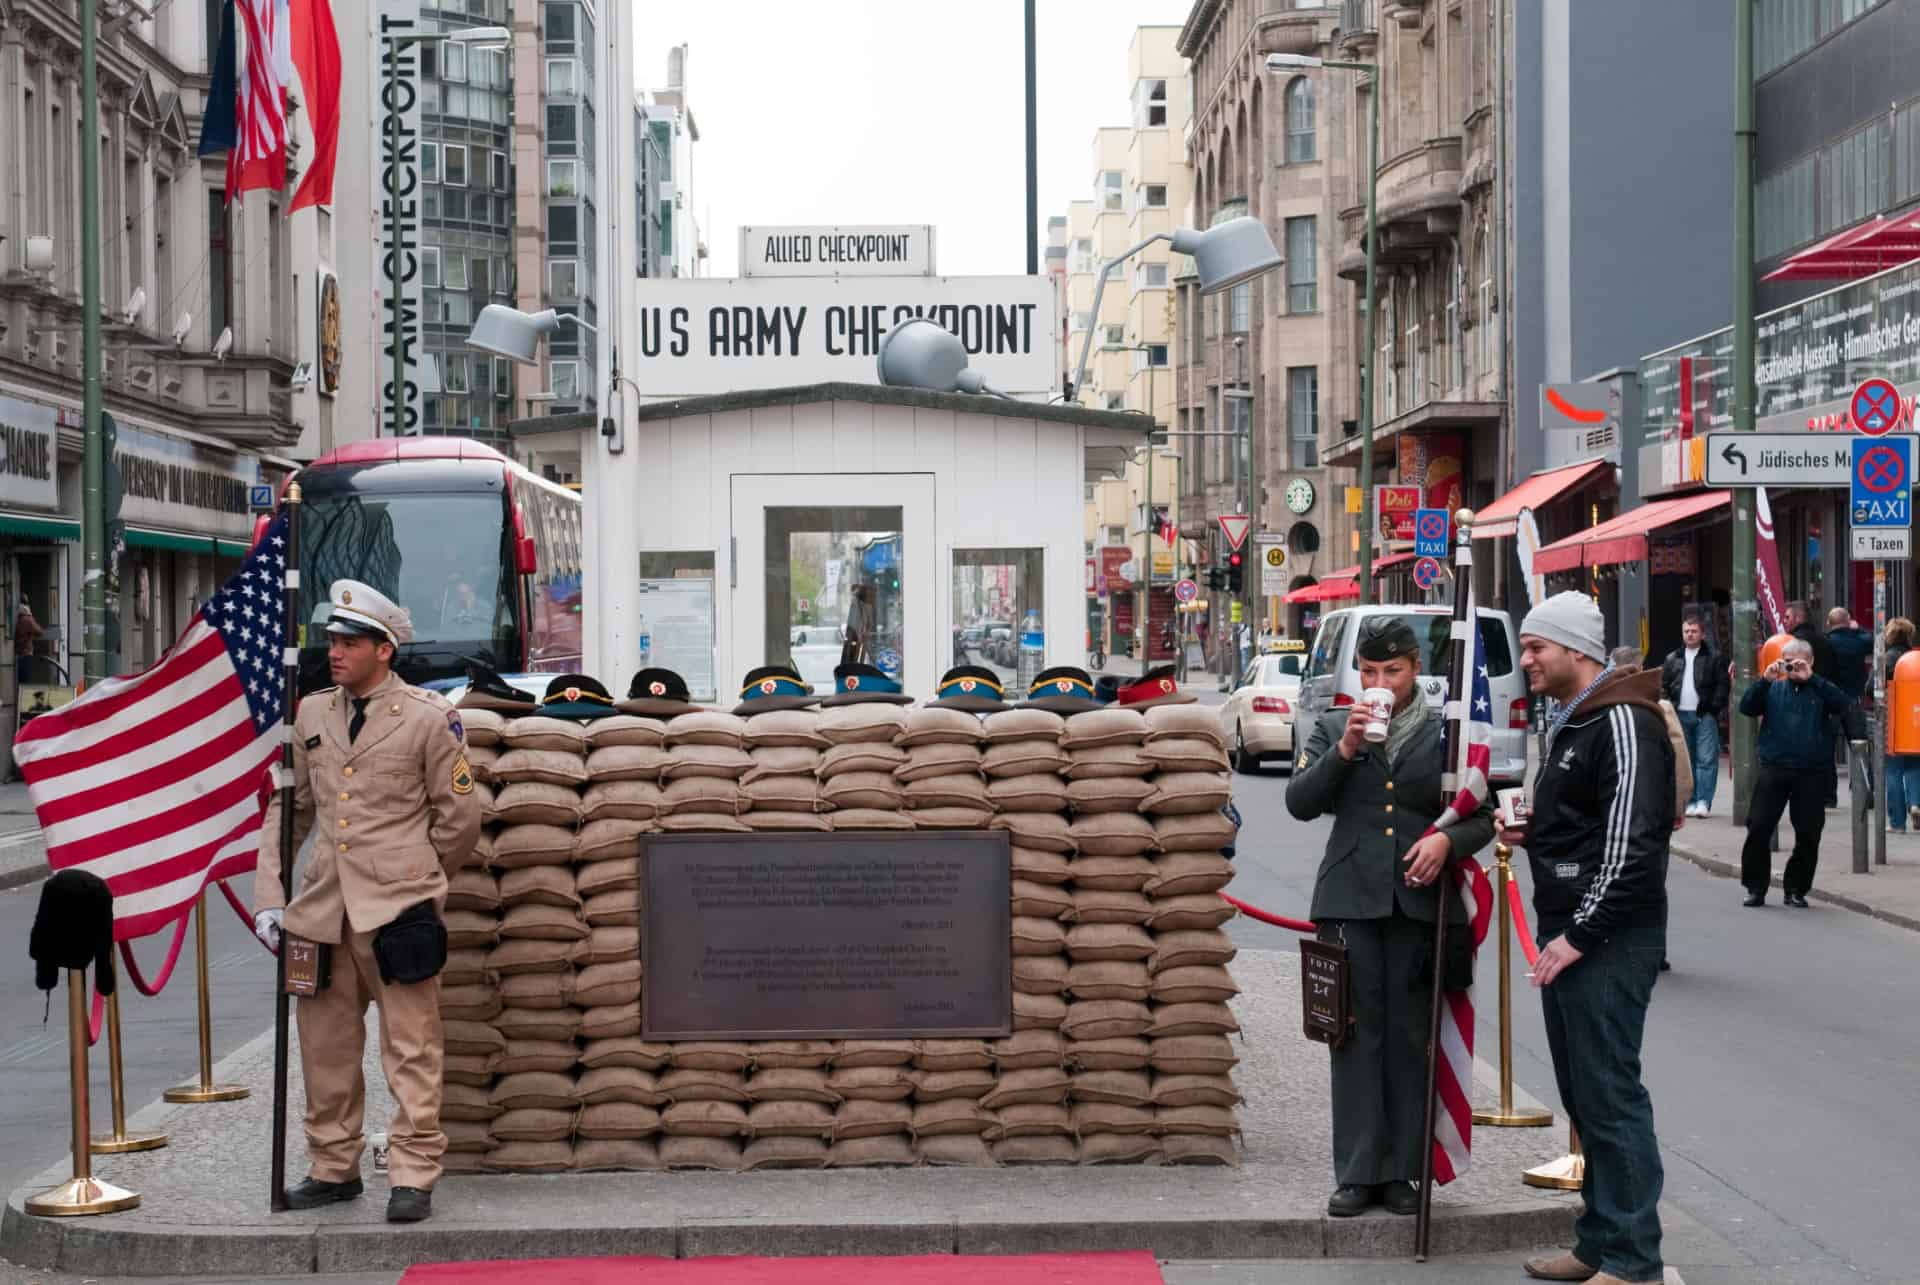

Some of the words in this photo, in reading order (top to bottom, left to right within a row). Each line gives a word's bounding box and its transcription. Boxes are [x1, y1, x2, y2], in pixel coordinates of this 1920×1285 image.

[381, 14, 417, 283] CHECKPOINT
[765, 235, 812, 263] ALLIED
[818, 234, 909, 263] CHECKPOINT
[383, 298, 418, 367] AM
[641, 306, 689, 357] US
[709, 306, 808, 357] ARMY
[825, 304, 1037, 357] CHEPOINT
[1754, 344, 1802, 385] ensationelle
[1803, 335, 1839, 373] Aussicht
[1844, 318, 1901, 361] Himmlischer
[383, 378, 418, 437] US
[1757, 449, 1829, 468] Jüdisches
[1835, 450, 1851, 468] M
[1856, 500, 1905, 519] TAXI
[1419, 542, 1444, 553] TAXI
[1870, 536, 1904, 550] Taxen
